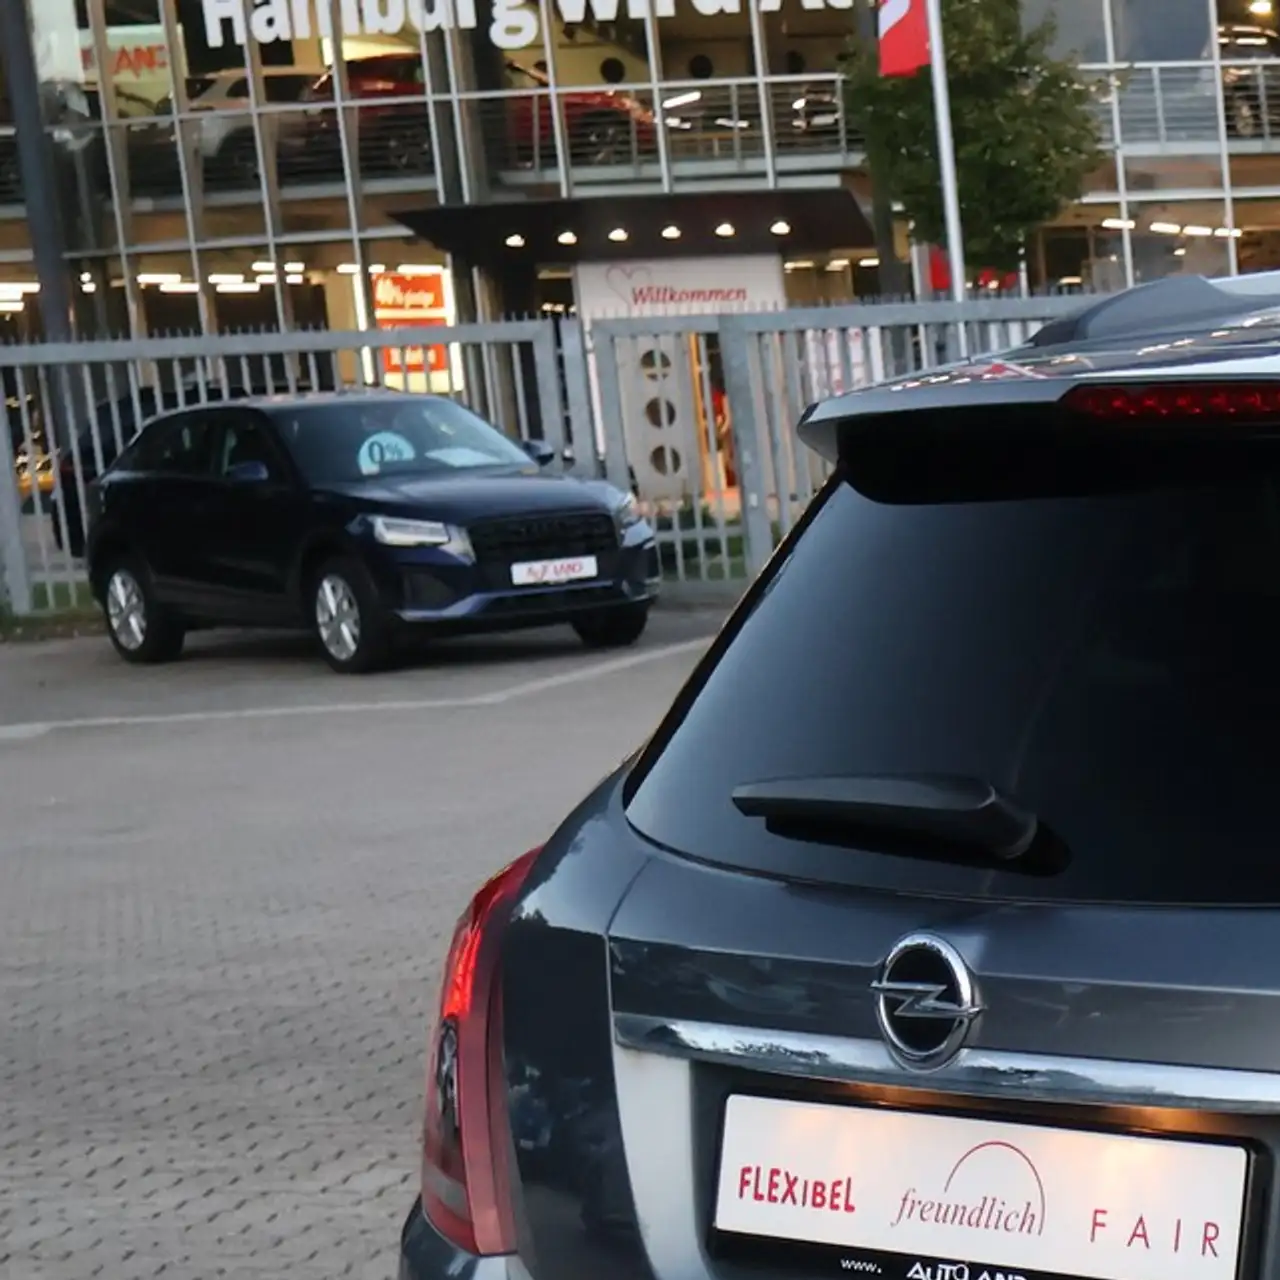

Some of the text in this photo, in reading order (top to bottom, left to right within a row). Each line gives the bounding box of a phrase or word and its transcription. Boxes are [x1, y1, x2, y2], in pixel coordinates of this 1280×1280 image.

[632, 285, 747, 306] Willkommen
[738, 1166, 1220, 1258] FLEXIBEL freundlich FAIR
[841, 1258, 883, 1275] www.
